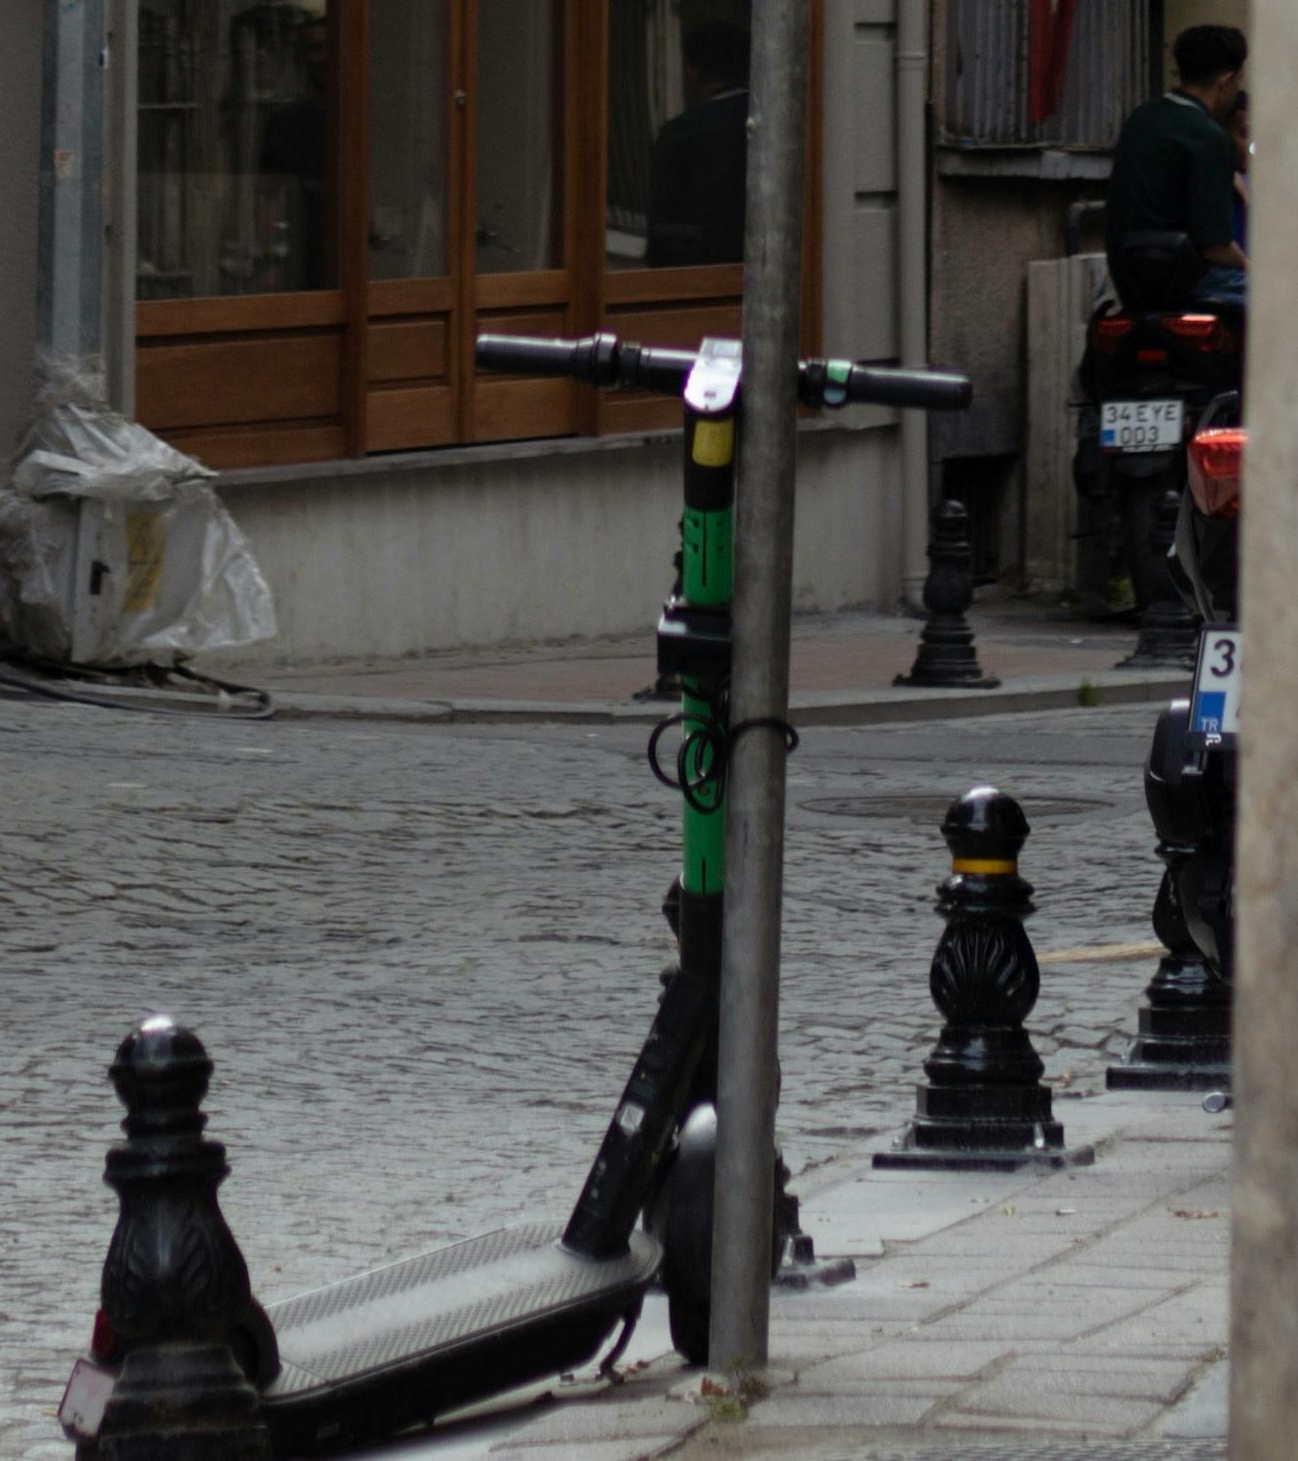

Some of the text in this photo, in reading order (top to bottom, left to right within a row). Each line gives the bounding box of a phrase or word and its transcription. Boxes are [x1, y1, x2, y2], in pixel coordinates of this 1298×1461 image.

[1106, 403, 1177, 424] 34 EYE
[1120, 424, 1160, 445] 003
[1209, 638, 1241, 679] 3
[1200, 716, 1219, 732] TR
